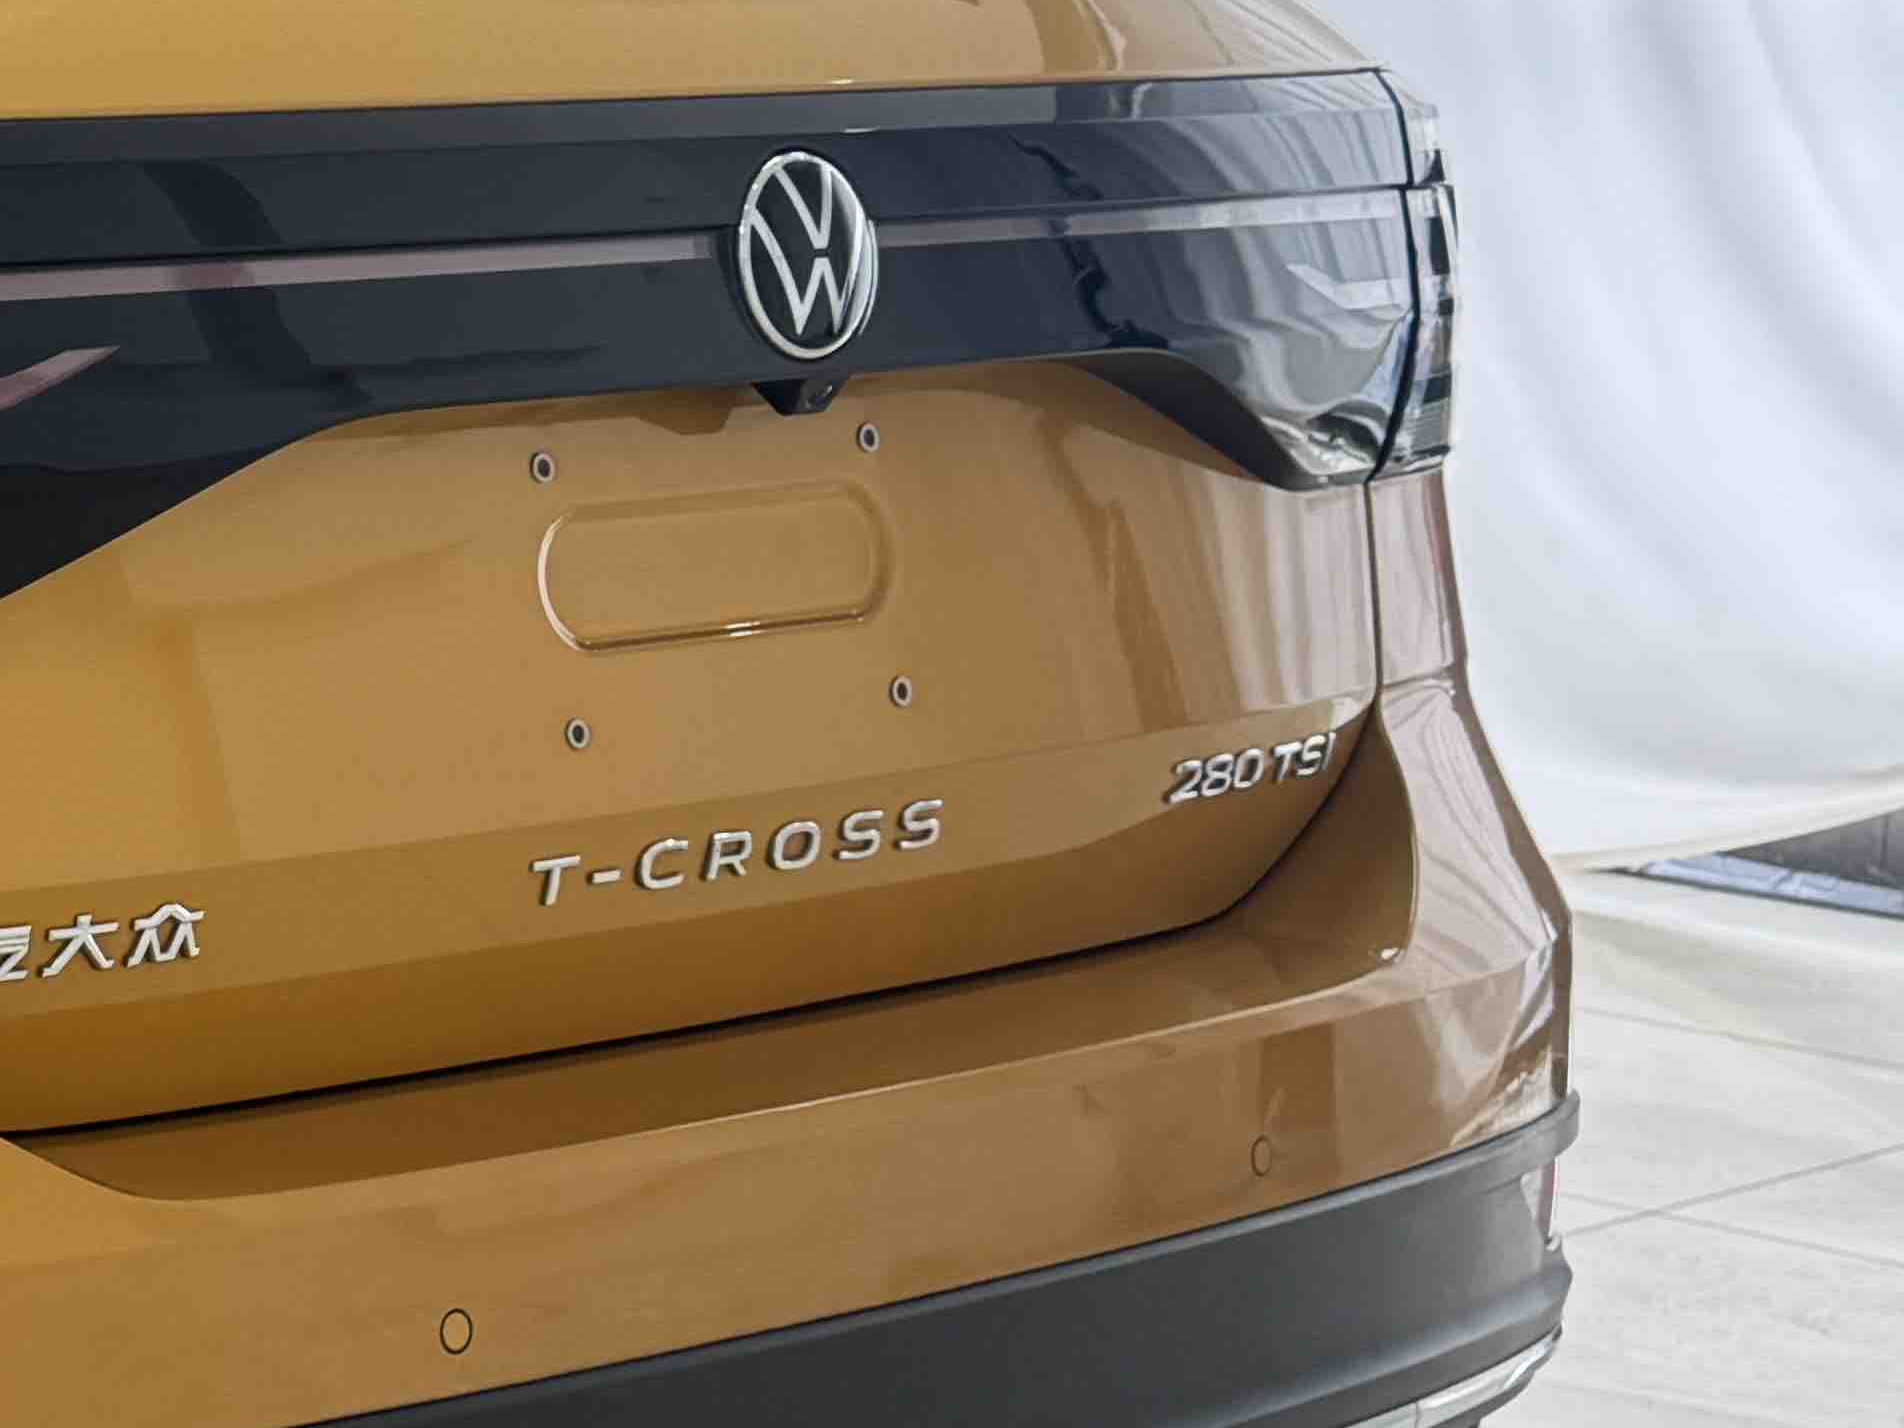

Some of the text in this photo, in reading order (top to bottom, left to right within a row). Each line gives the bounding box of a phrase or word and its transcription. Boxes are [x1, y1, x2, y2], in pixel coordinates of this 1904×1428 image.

[1168, 731, 1337, 804] 280 TSI
[530, 798, 944, 907] T-CROSS
